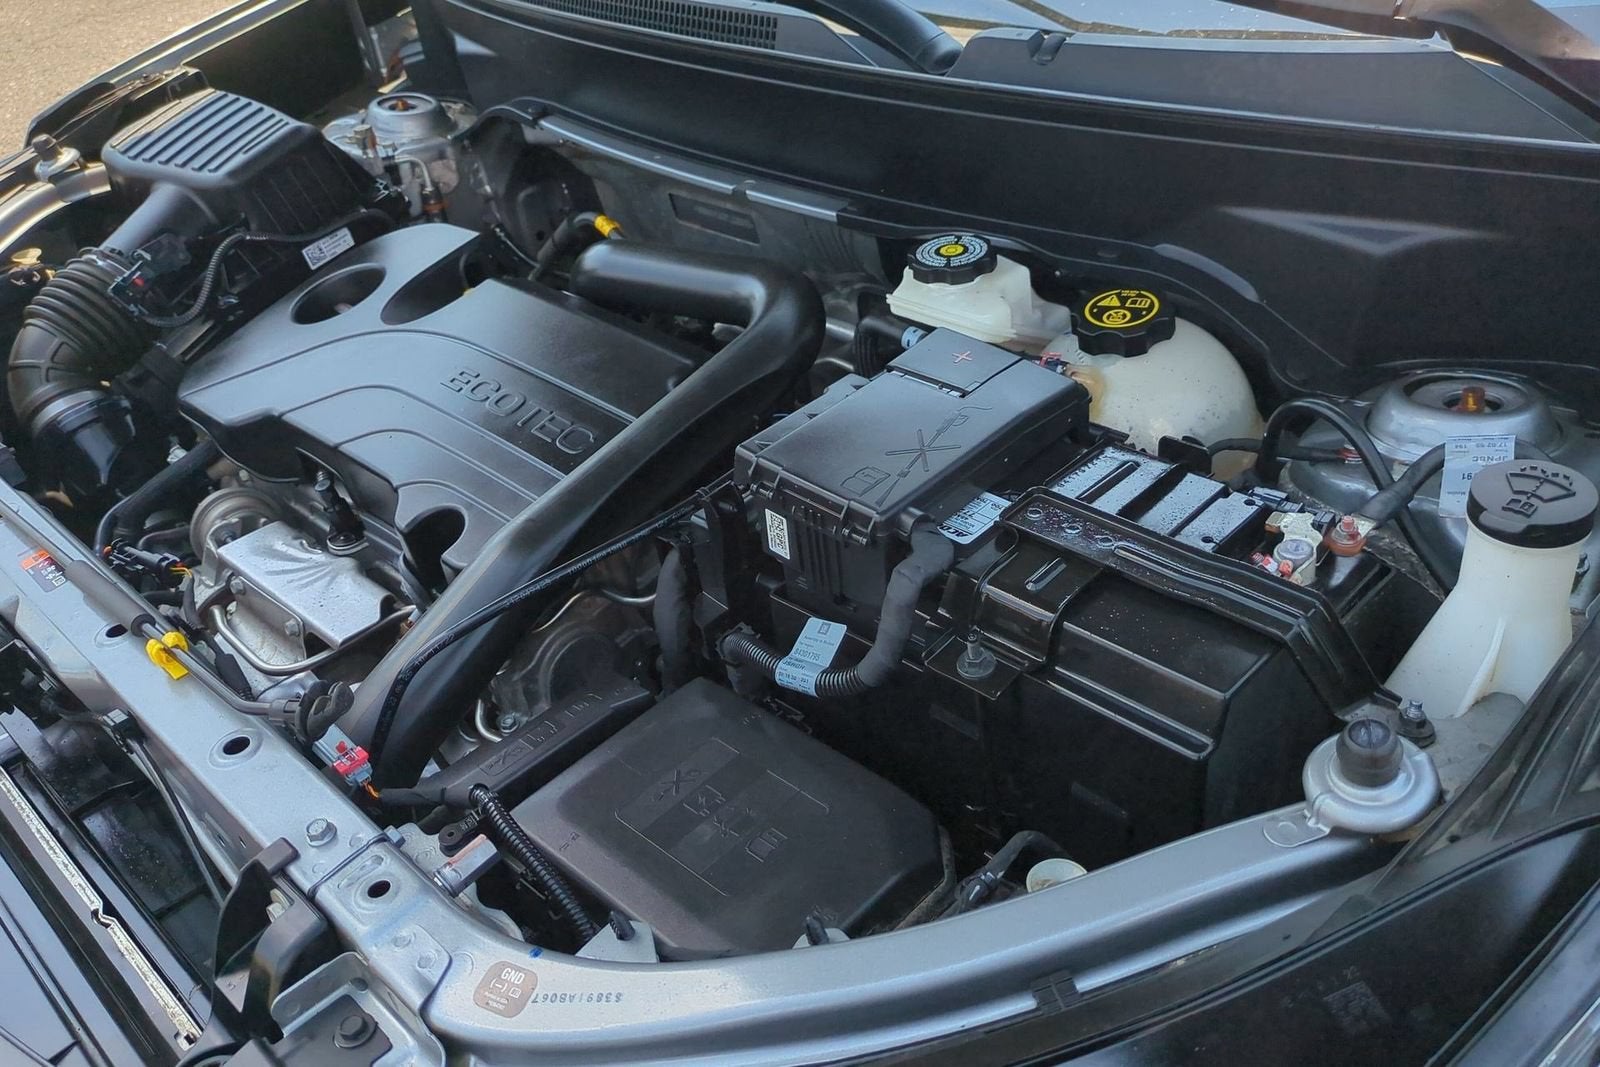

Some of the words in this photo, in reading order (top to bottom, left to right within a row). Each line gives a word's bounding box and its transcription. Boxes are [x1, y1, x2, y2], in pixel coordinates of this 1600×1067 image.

[440, 367, 597, 455] ECOTEC
[935, 524, 969, 537] ACD
[500, 967, 525, 985] GND
